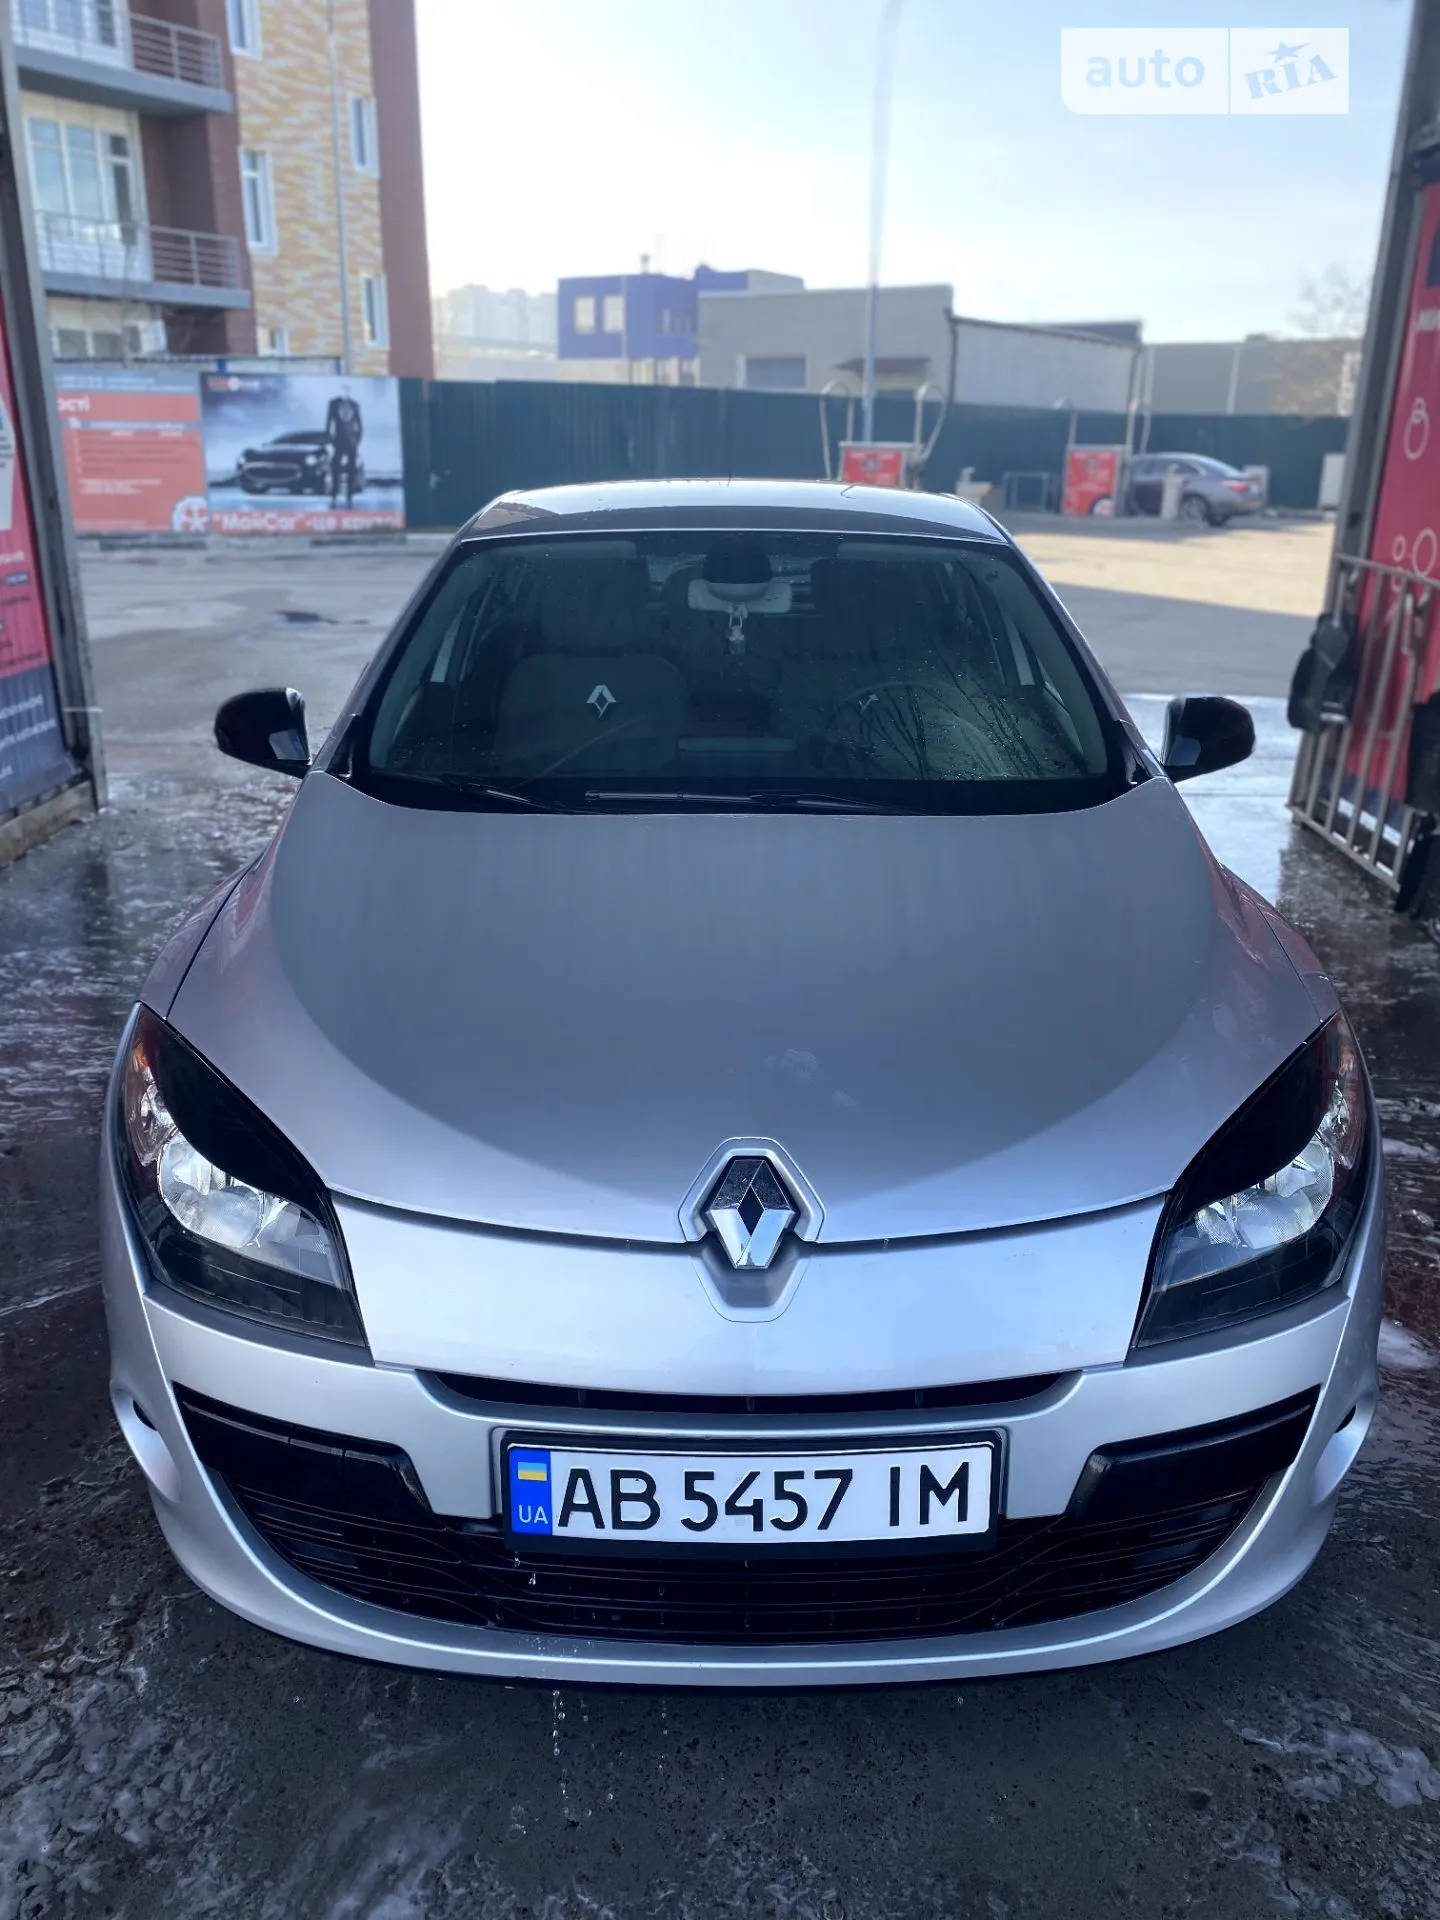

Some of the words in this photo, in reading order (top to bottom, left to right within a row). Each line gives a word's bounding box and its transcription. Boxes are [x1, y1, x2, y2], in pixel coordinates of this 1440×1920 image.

[518, 1504, 549, 1526] UA
[557, 1467, 662, 1531] AB
[680, 1468, 854, 1533] 5457
[888, 1461, 971, 1528] IM
